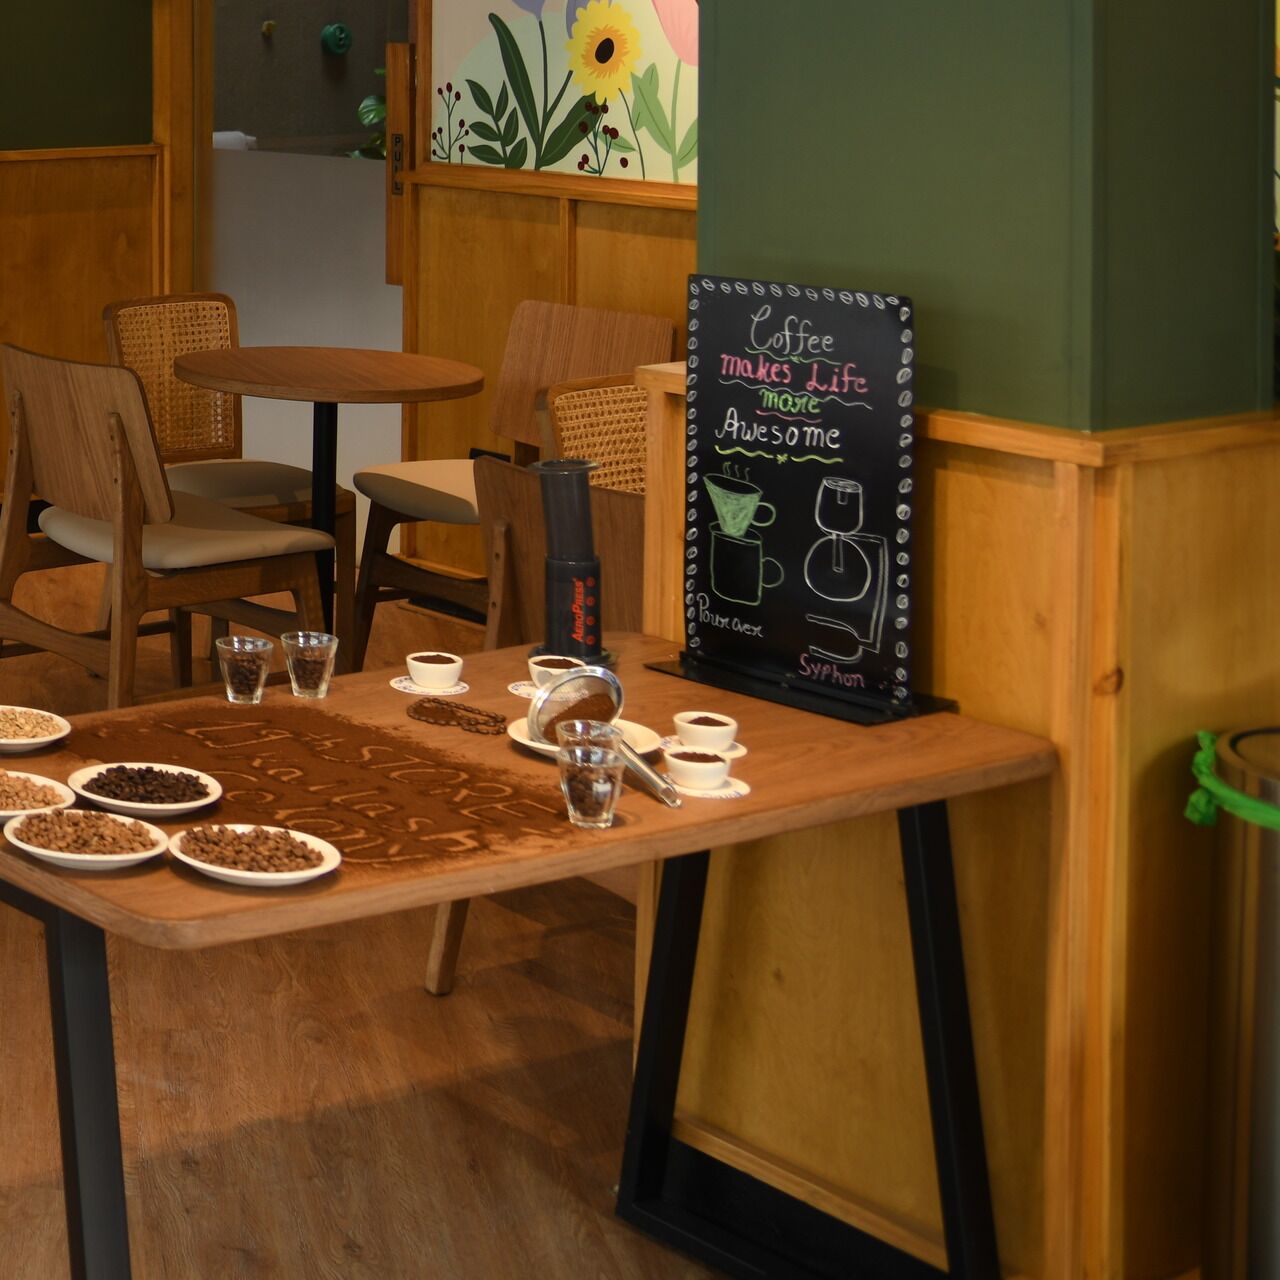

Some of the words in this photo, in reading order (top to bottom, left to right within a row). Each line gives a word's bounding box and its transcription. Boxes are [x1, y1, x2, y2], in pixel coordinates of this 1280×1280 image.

[749, 304, 835, 356] Coffee
[720, 352, 794, 384] makes
[806, 362, 869, 394] Life
[758, 388, 821, 413] more
[714, 407, 841, 449] Awesome
[799, 652, 865, 689] Syphon
[320, 744, 560, 821] STORE
